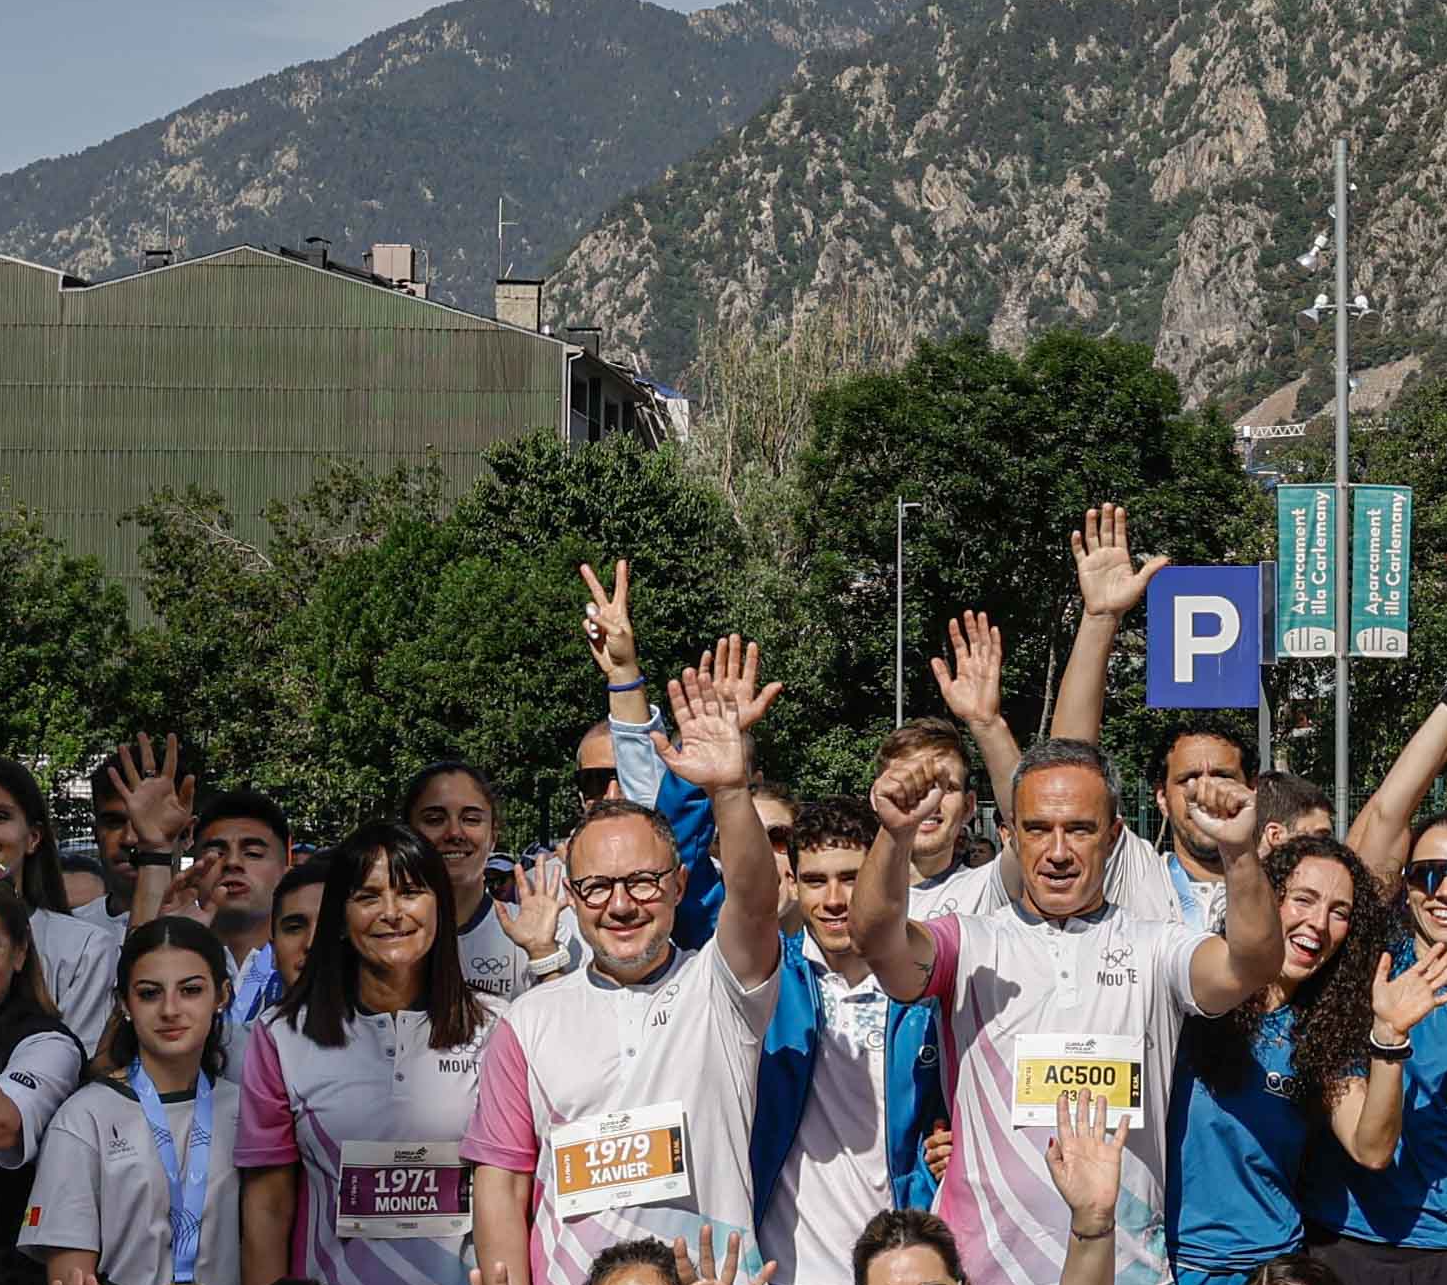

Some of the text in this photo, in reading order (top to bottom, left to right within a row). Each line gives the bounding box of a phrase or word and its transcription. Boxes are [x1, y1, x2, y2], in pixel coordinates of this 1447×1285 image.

[1291, 508, 1307, 615] Aparcament
[1311, 490, 1331, 616] illa Carlemany
[1364, 508, 1381, 616] Aparcament
[1384, 491, 1408, 616] illa Carlemany
[1173, 594, 1241, 684] P
[1290, 627, 1326, 651] illa
[1363, 627, 1399, 651] illa
[1097, 968, 1138, 987] MOU-TE
[438, 1058, 479, 1075] MOU-T
[1044, 1065, 1115, 1087] AC500
[584, 1134, 650, 1168] 1979
[373, 1168, 439, 1193] 1971
[589, 1161, 649, 1186] XAVIER
[374, 1194, 438, 1212] MONICA
